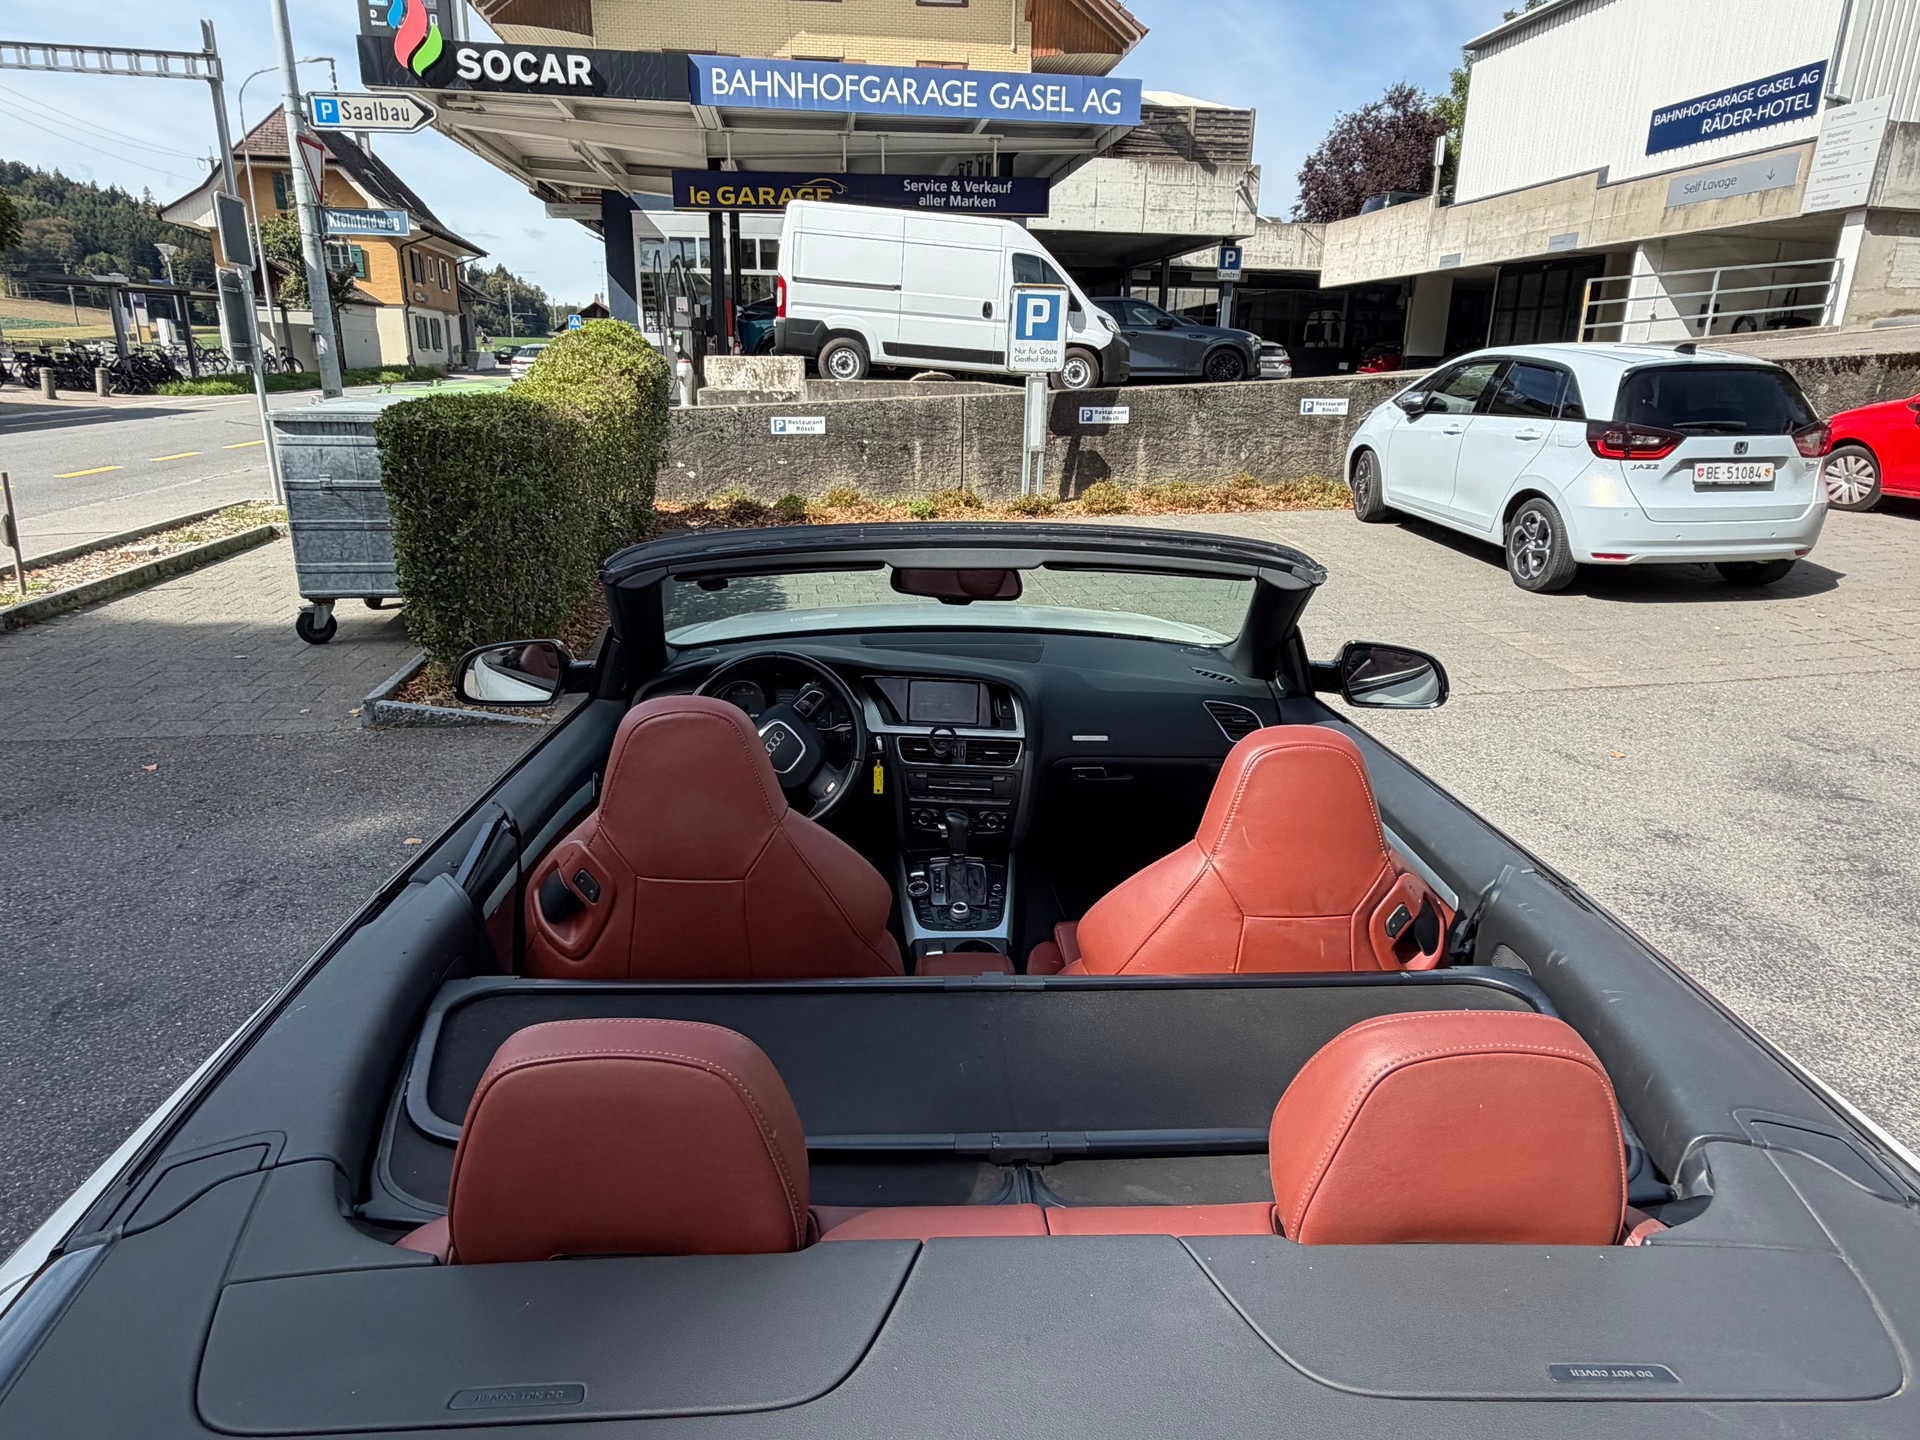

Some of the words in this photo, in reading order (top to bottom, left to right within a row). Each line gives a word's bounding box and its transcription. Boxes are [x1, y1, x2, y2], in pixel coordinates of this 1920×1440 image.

[456, 48, 593, 86] SOCAR
[711, 67, 978, 107] BAHNHOFGARAGE
[989, 82, 1075, 112] GASEL
[1082, 88, 1122, 115] AG
[1653, 87, 1756, 127] BAHNHOFGARAGE
[1757, 77, 1796, 98] GASEL
[1798, 69, 1820, 87] AG
[321, 102, 333, 120] P
[341, 101, 411, 122] Saalbau
[1701, 92, 1813, 135] RÄDER-HOTEL
[903, 179, 947, 192] Service
[951, 180, 961, 193] &
[964, 181, 1013, 194] Verkauf
[1683, 180, 1702, 195] Self
[1702, 176, 1737, 191] Lavage
[689, 186, 711, 205] le
[716, 186, 833, 206] GARAGE
[918, 194, 946, 207] aller
[949, 195, 996, 208] Marken
[328, 213, 400, 231] Kleinfeldweg
[1225, 250, 1236, 268] P
[1219, 271, 1240, 279] Kunden
[1025, 298, 1051, 337] P
[1014, 355, 1039, 363] Gasthof
[1039, 347, 1058, 355] Gäste
[1570, 1369, 1609, 1377] COVER
[1612, 1369, 1635, 1378] NOT
[1636, 1370, 1654, 1378] DO
